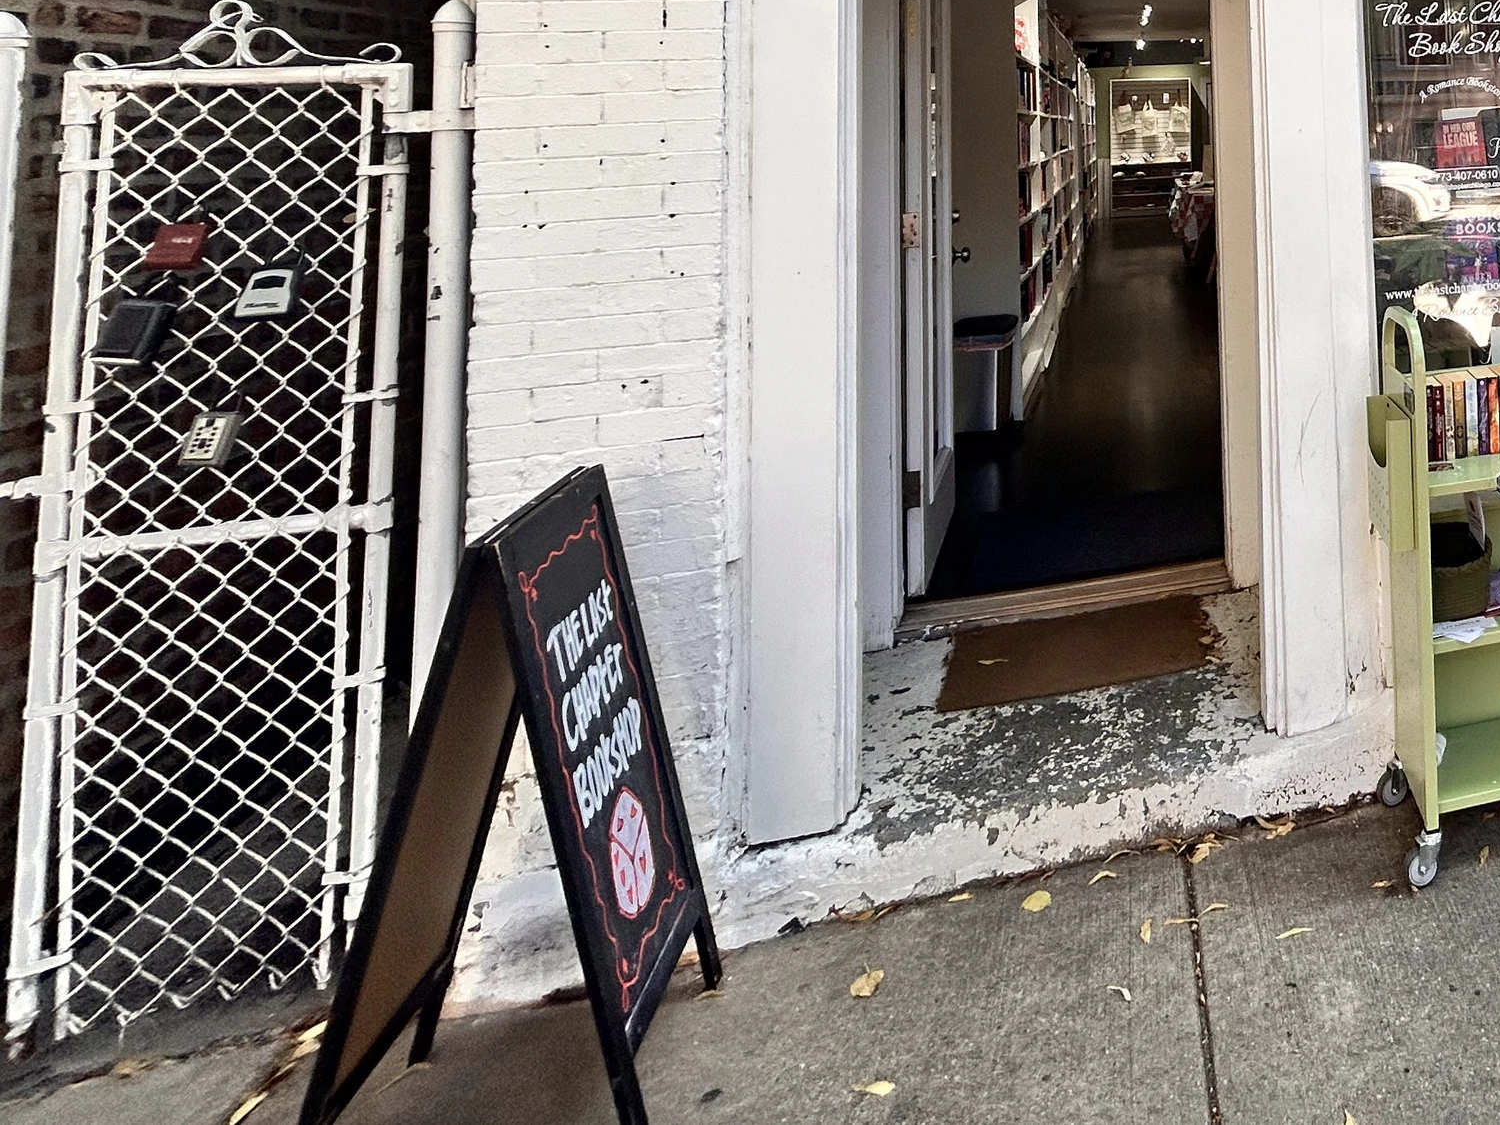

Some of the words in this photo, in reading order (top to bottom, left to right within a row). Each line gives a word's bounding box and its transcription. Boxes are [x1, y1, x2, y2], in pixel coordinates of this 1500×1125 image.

[1375, 1, 1412, 27] The
[1414, 2, 1468, 26] Last
[1408, 32, 1463, 58] Book
[1426, 78, 1465, 95] Romance
[1443, 131, 1478, 149] LEAGUE
[547, 609, 584, 683] THE
